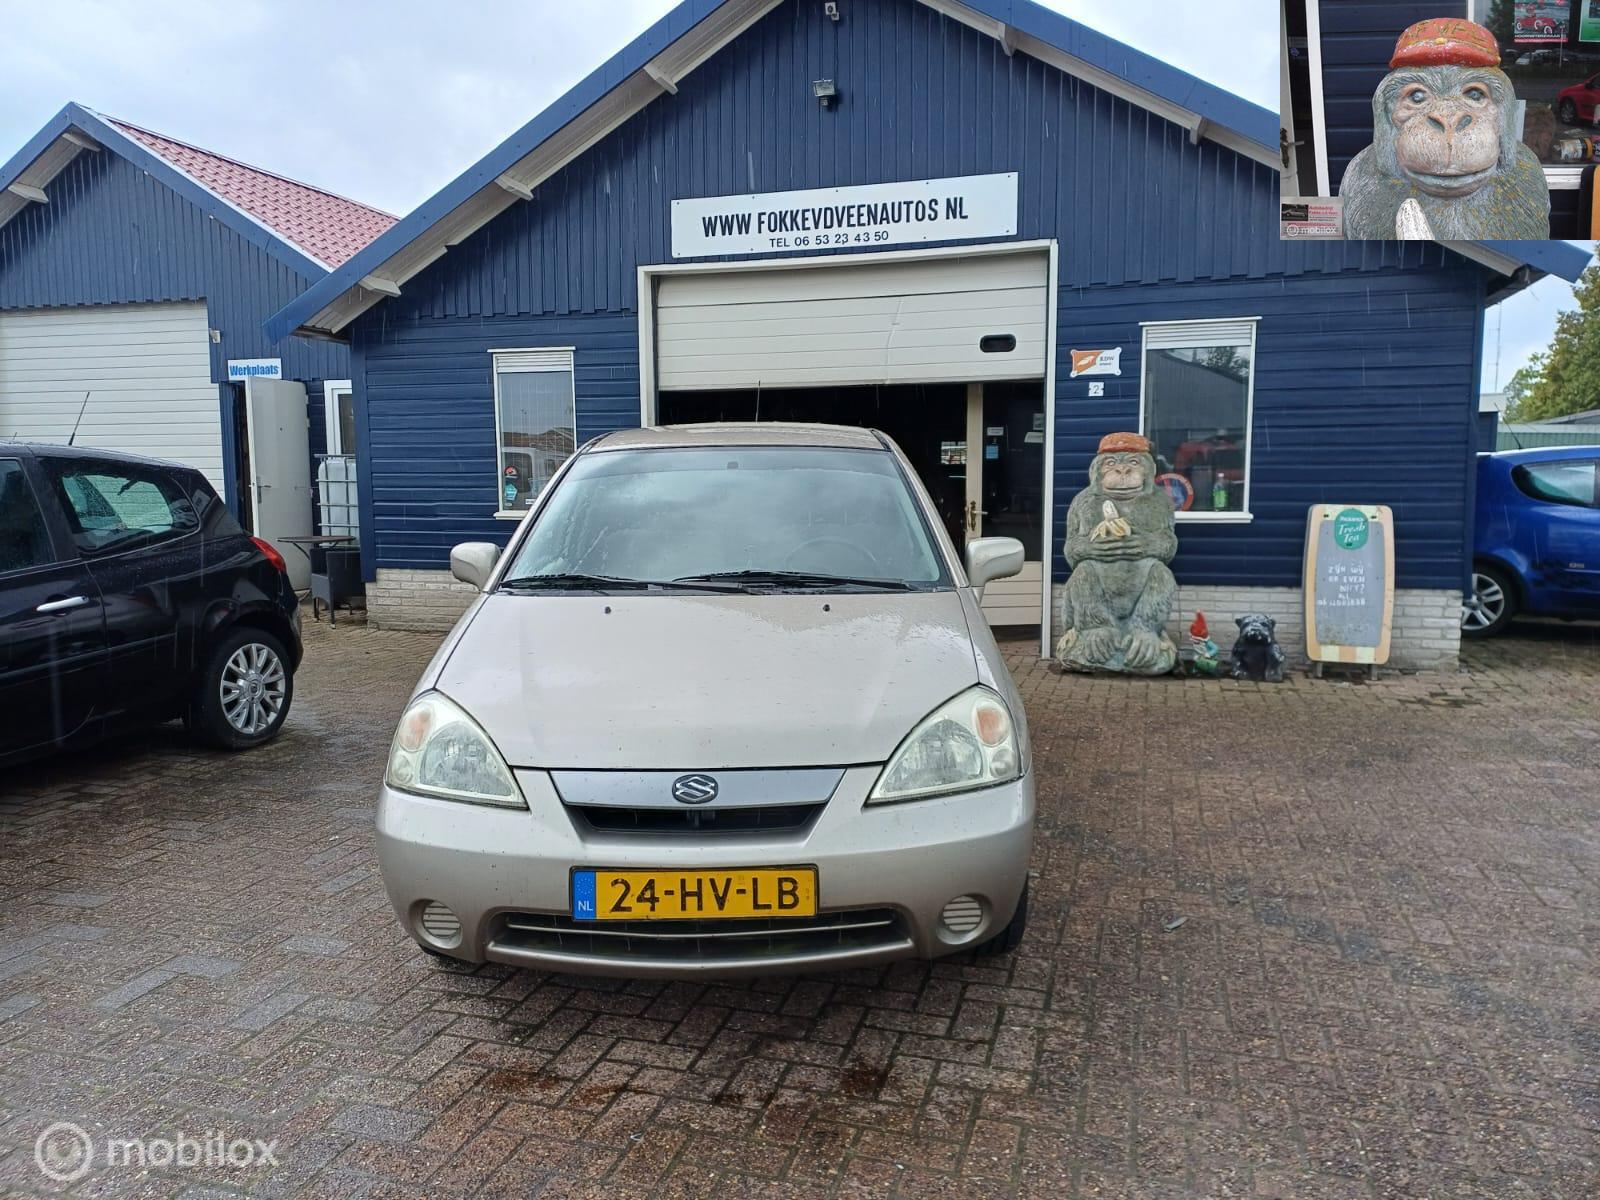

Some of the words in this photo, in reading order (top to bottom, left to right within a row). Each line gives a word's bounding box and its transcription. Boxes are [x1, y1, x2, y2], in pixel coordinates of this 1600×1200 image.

[701, 212, 752, 237] WWW
[757, 199, 939, 234] FOKKEVDVEENAUTOS
[945, 196, 969, 220] NL
[769, 237, 790, 248] TEL
[794, 236, 810, 246] 06
[815, 235, 830, 245] 53
[834, 233, 849, 244] 23
[854, 232, 870, 243] 43
[874, 230, 889, 241] 50
[229, 364, 279, 377] Werkplaats
[1093, 384, 1100, 394] 2
[578, 900, 593, 911] NL
[609, 876, 800, 912] 24-HV-LB
